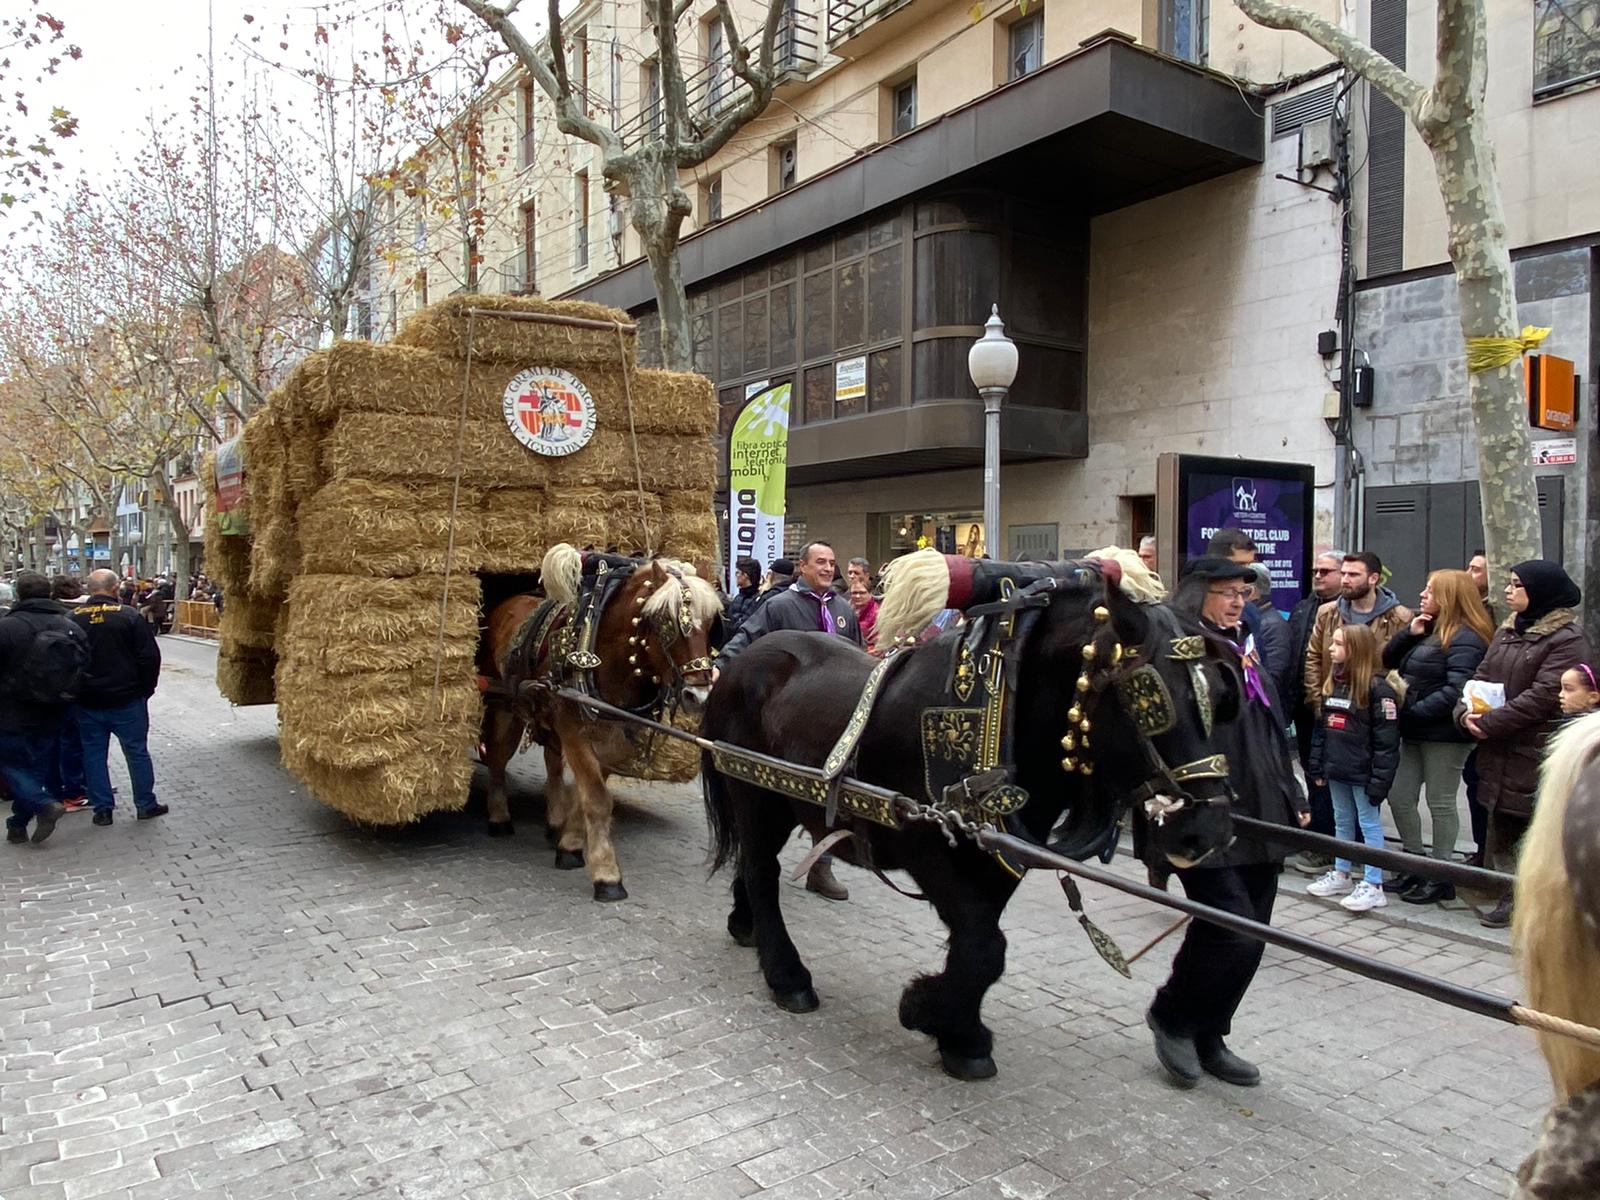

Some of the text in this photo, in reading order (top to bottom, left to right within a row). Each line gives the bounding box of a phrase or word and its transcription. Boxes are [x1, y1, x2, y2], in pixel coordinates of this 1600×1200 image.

[509, 366, 544, 392] GREMI
[550, 367, 565, 380] DE
[569, 375, 596, 438] TRAGINERS
[1546, 409, 1571, 425] orange
[737, 441, 758, 450] fibra
[733, 447, 781, 459] internet
[1253, 529, 1268, 541] DEL
[1268, 530, 1290, 542] CLUB
